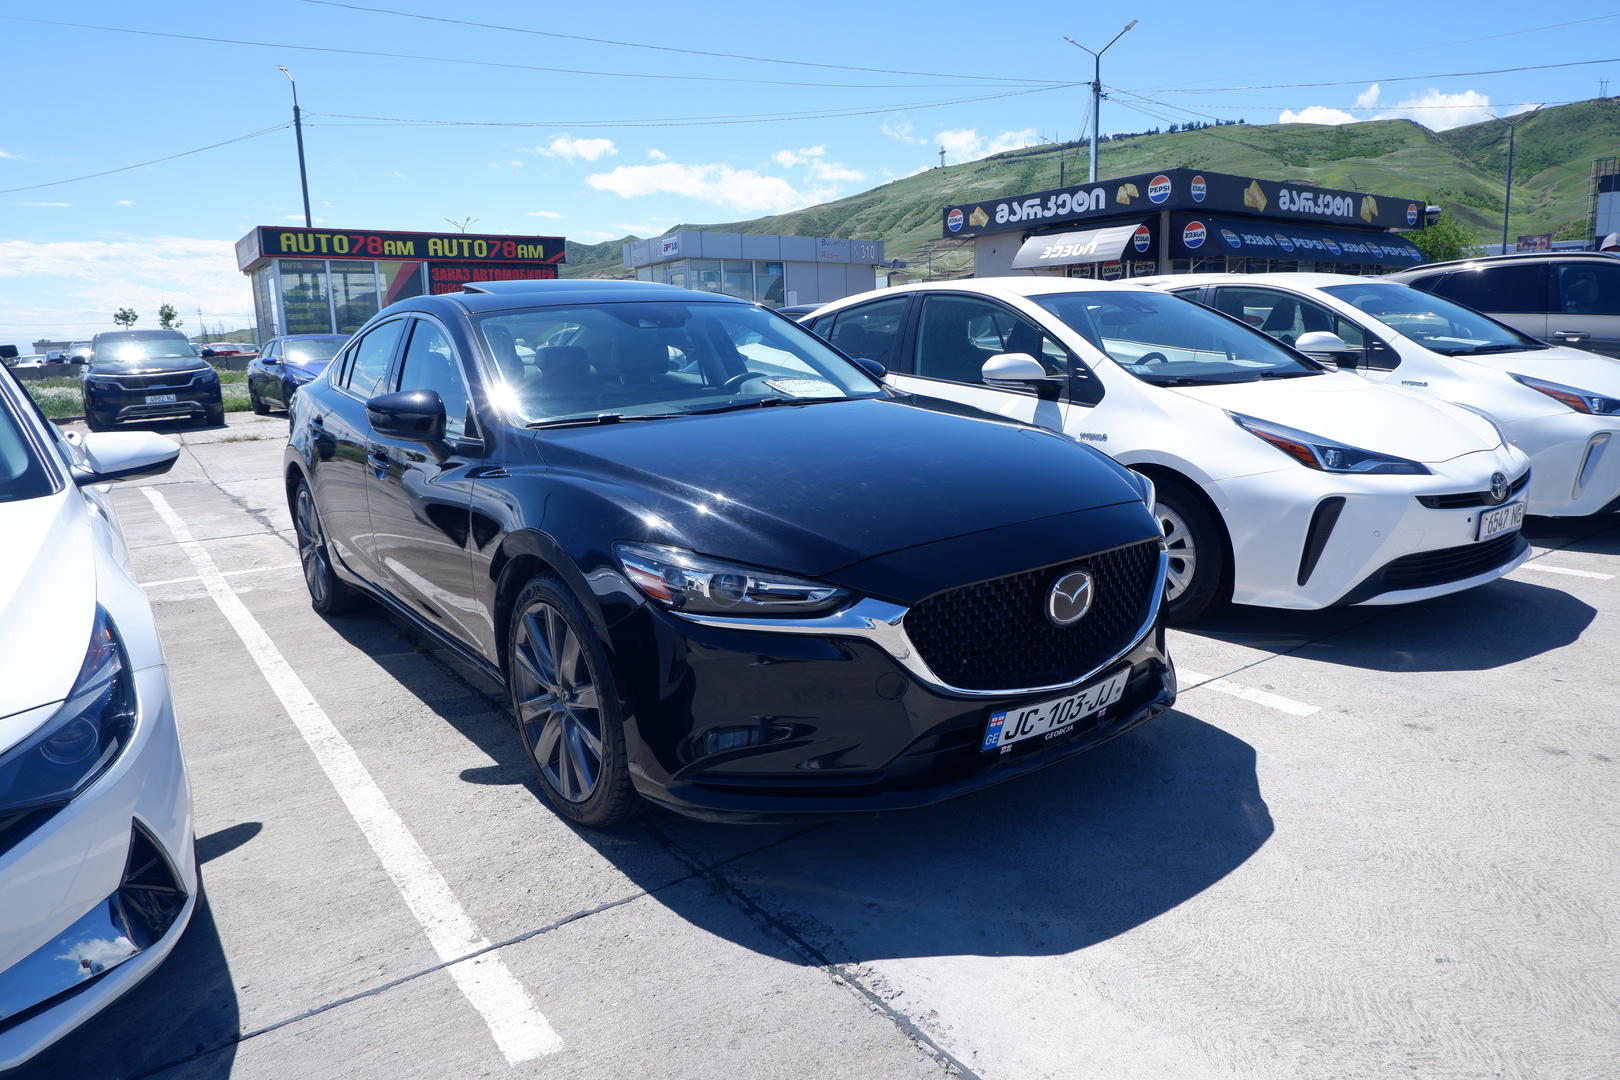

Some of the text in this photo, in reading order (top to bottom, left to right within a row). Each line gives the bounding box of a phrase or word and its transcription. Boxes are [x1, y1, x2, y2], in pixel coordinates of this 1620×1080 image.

[1150, 185, 1170, 194] PEPSI
[995, 188, 1106, 224] მარკეტი
[1278, 188, 1353, 217] მარკეტი
[1290, 237, 1326, 250] PEPSI
[1381, 245, 1410, 257] PEPSI
[1004, 679, 1116, 740] JC-103-JJ
[985, 732, 999, 746] GE
[1044, 725, 1074, 740] GEORGIA
